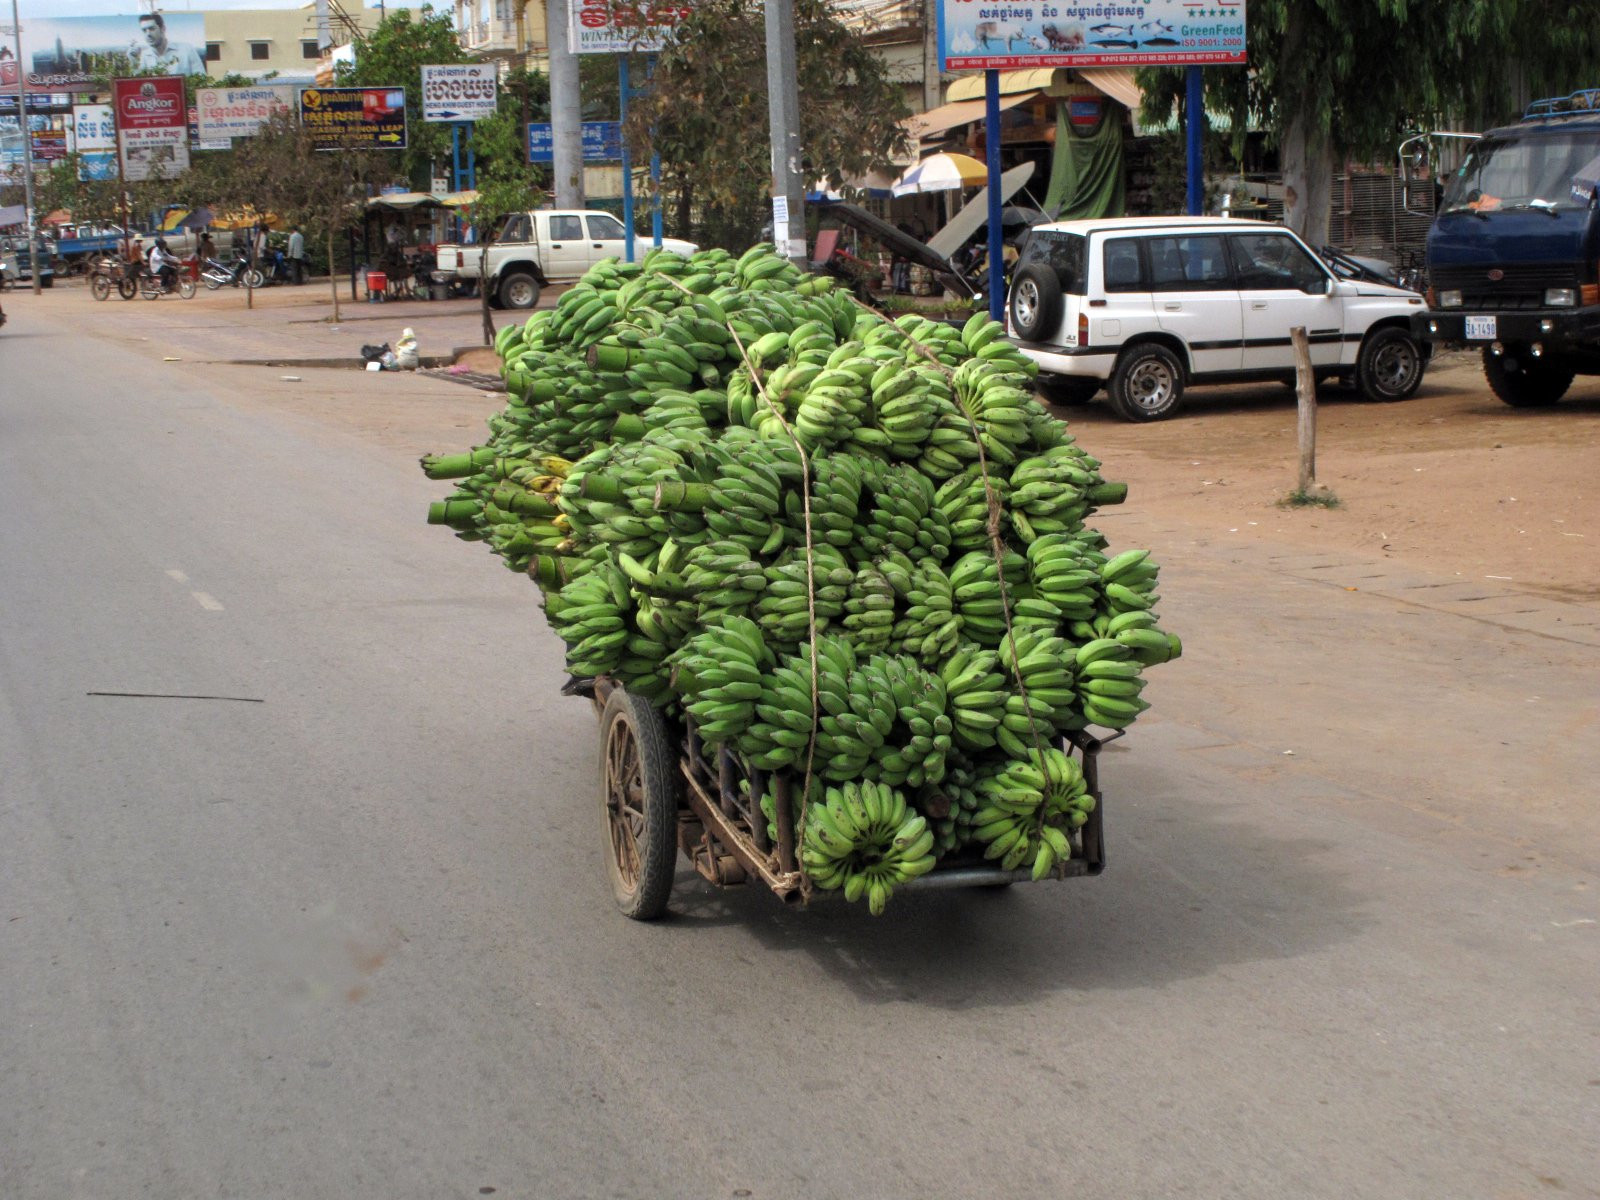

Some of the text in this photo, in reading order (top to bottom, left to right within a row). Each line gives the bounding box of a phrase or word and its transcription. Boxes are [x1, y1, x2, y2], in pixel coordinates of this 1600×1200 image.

[1181, 24, 1244, 36] GreenFeed
[1181, 38, 1196, 47] ISO
[1222, 37, 1242, 46] 2000
[127, 98, 174, 112] Angkor
[381, 124, 404, 132] LEAP
